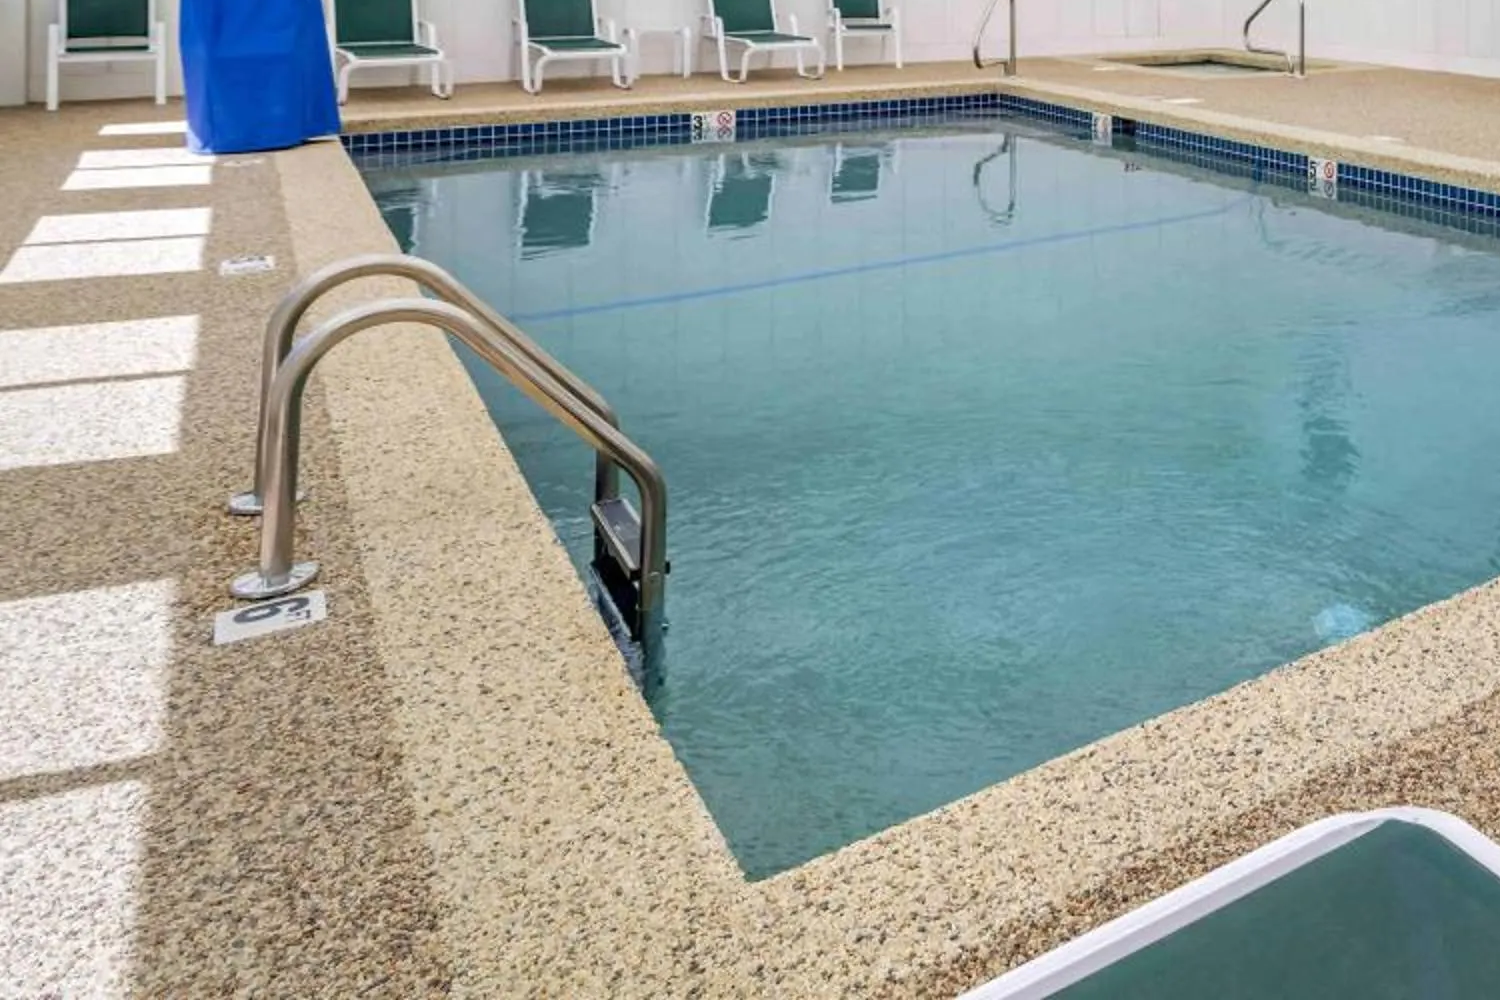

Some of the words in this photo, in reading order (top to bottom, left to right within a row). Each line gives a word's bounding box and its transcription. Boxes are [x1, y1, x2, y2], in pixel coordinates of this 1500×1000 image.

[693, 115, 703, 129] 3
[1309, 160, 1317, 179] 5
[233, 597, 310, 624] 6
